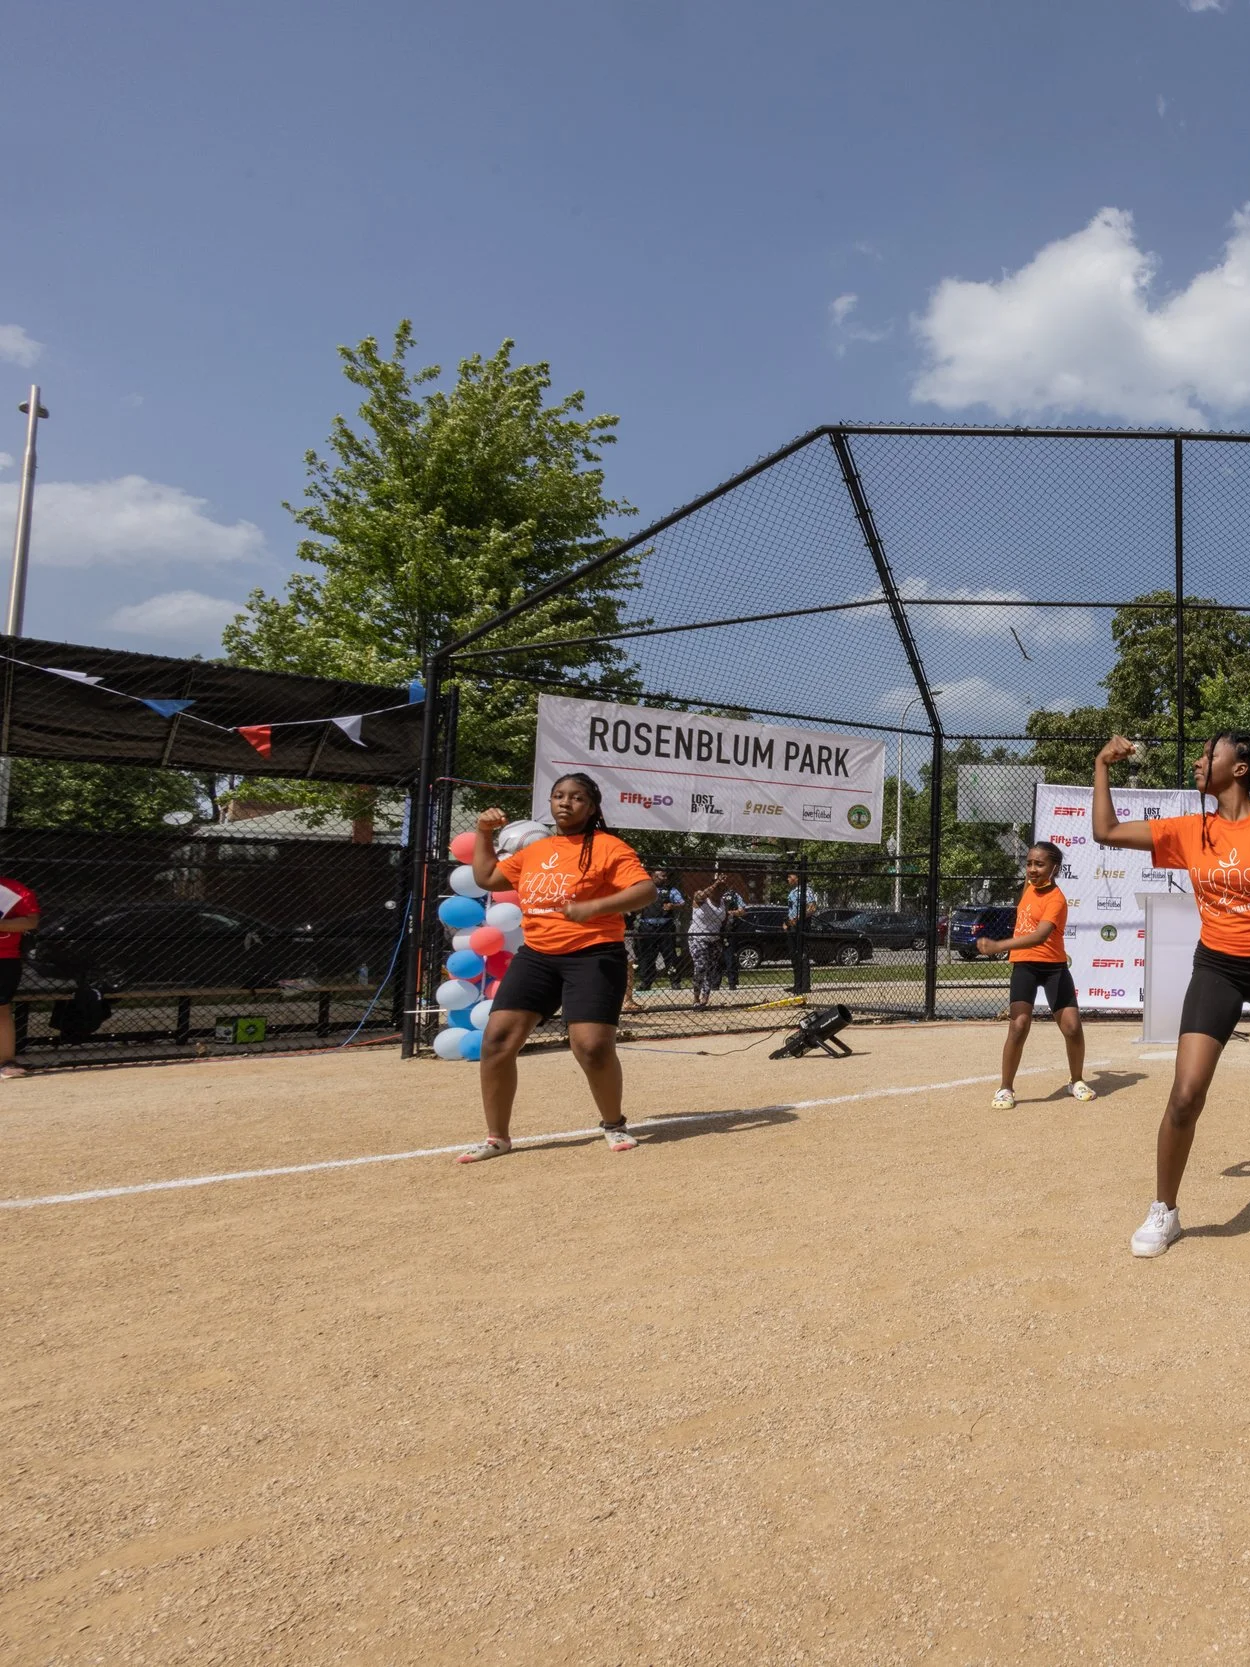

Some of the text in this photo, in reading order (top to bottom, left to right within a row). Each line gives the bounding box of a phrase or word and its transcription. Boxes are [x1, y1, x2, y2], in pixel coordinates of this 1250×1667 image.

[588, 716, 851, 778] ROSENBLUM PARK
[692, 793, 715, 805] LOST
[753, 803, 784, 815] RISE
[1054, 806, 1086, 817] ESPN
[1144, 807, 1161, 816] LOST
[1102, 870, 1126, 879] RISE
[1092, 959, 1124, 968] ESPN
